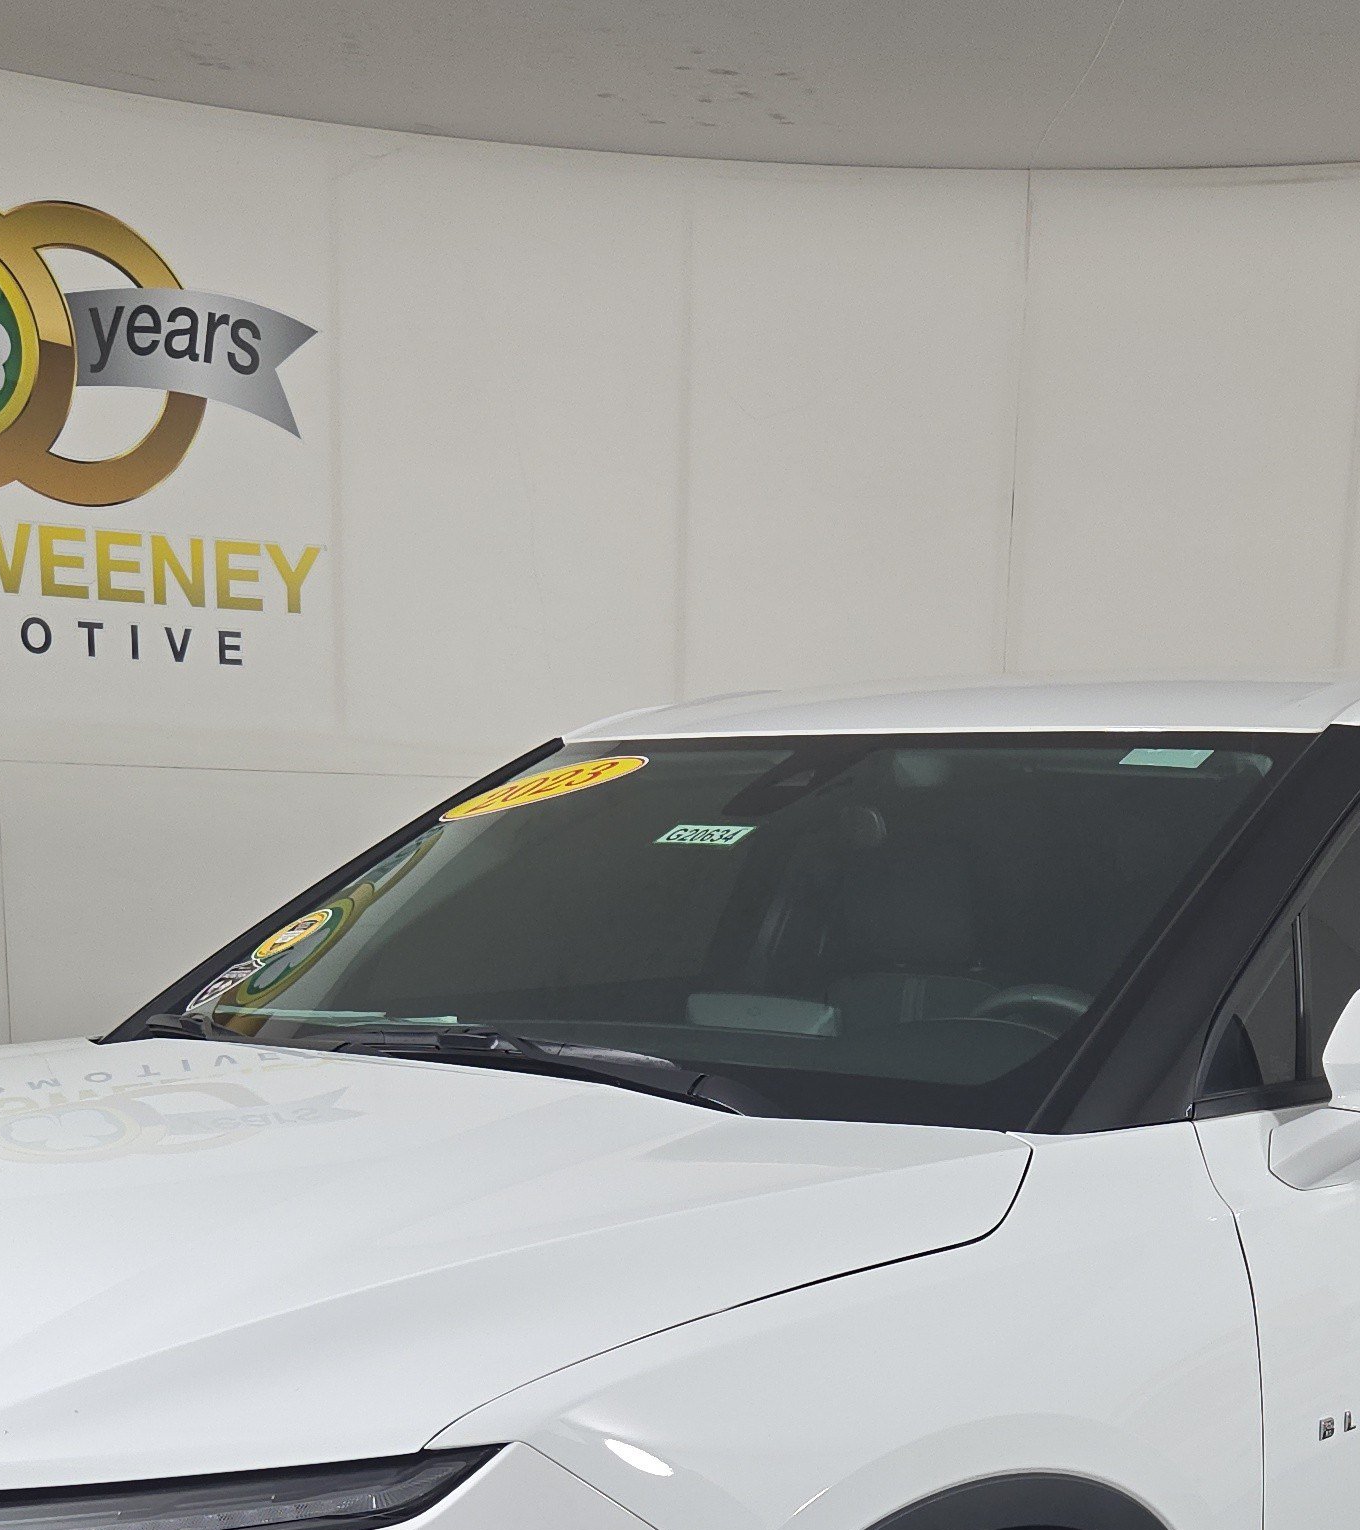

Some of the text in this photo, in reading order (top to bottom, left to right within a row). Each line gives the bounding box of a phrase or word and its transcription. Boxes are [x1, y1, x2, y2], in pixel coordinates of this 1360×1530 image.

[89, 303, 261, 375] years
[464, 761, 619, 813] 2023
[666, 827, 741, 843] G20634
